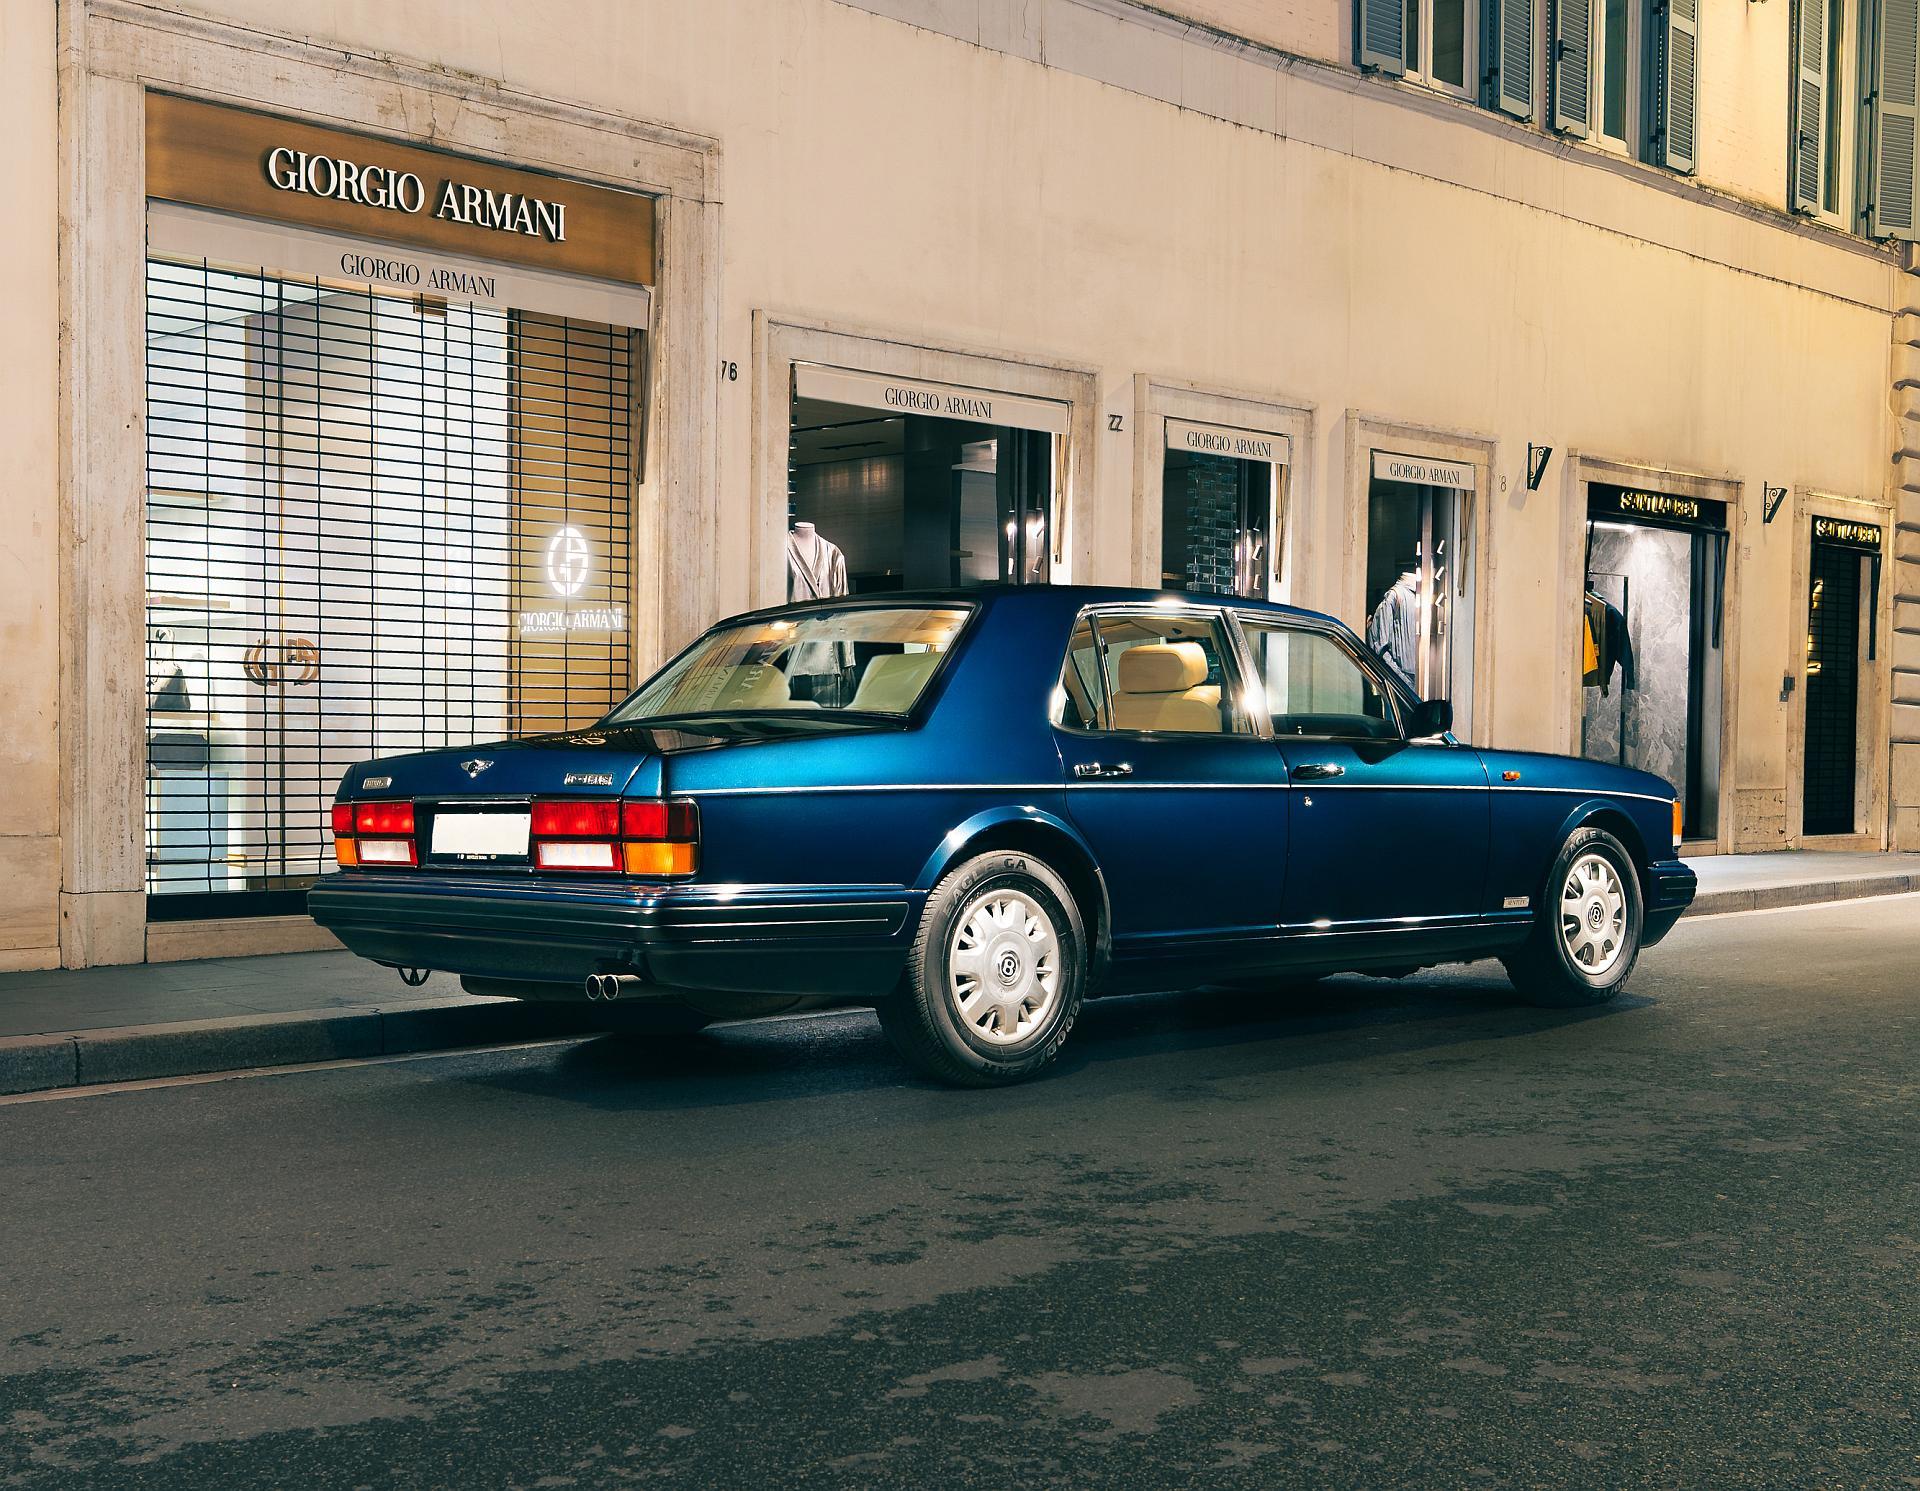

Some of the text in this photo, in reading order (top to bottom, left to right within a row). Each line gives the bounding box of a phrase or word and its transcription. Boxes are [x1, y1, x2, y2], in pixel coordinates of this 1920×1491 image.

[268, 147, 567, 242] GIORGIO ARMANI
[340, 253, 497, 299] GIORGIO ARMANI
[884, 387, 993, 419] GIORGIO ARMANI
[1186, 430, 1272, 458] GIORGIO ARMANI
[1389, 462, 1461, 485] GIORGIO ARMANI
[1002, 857, 1028, 871] GA
